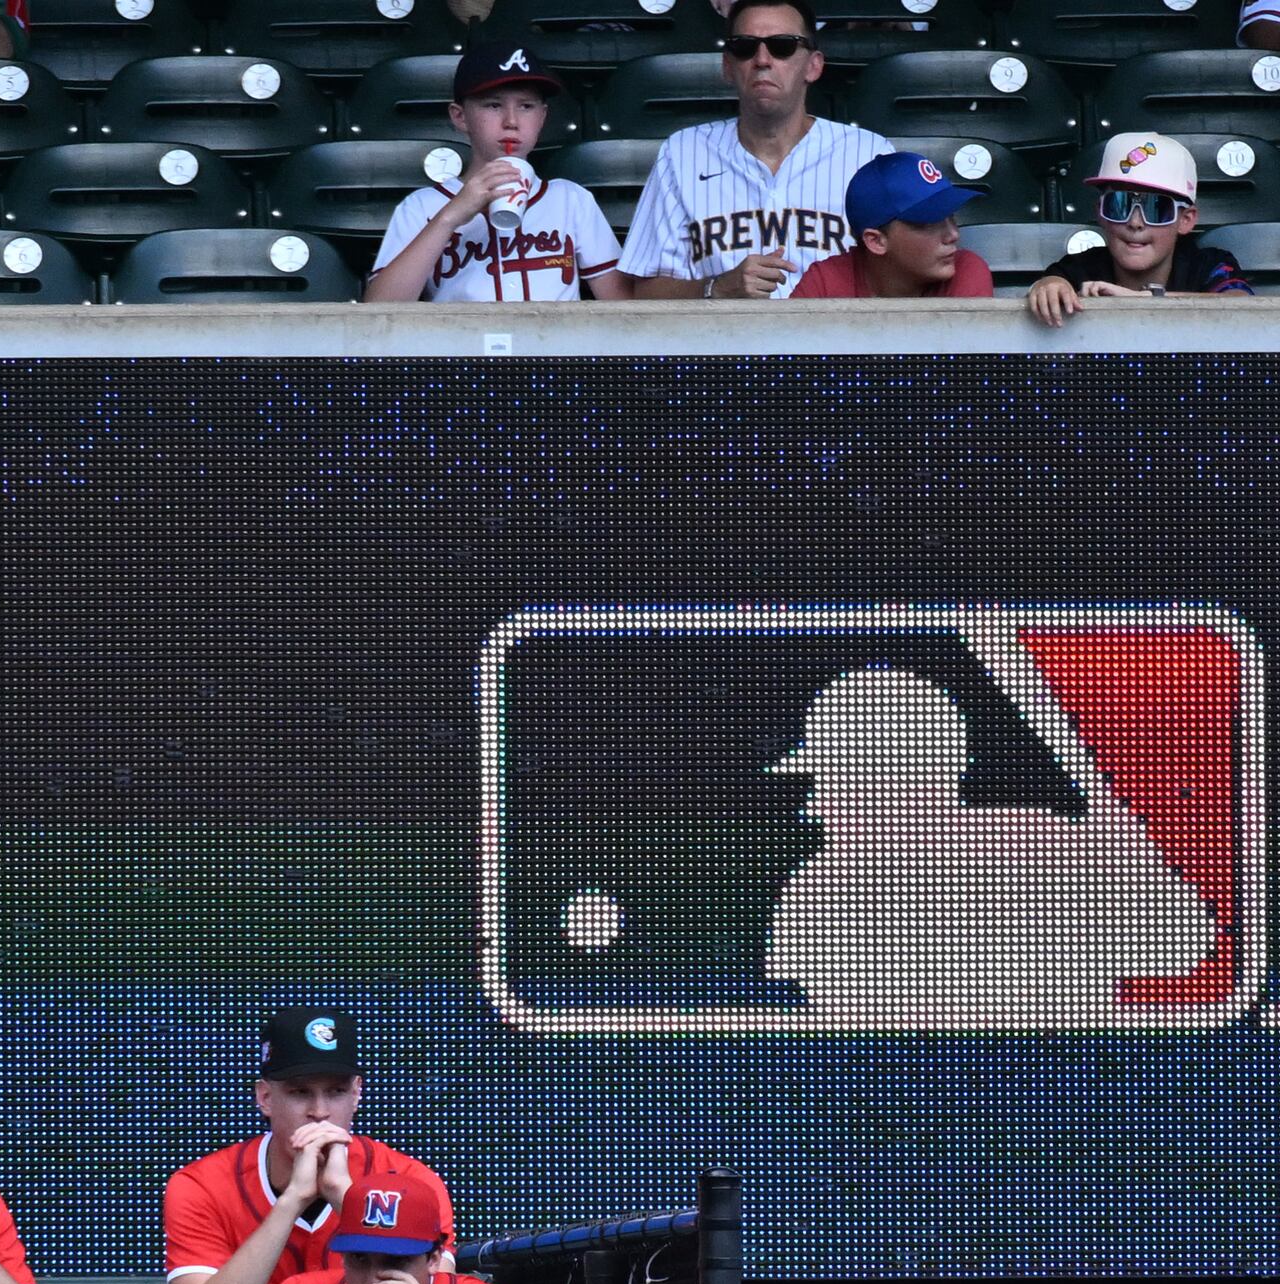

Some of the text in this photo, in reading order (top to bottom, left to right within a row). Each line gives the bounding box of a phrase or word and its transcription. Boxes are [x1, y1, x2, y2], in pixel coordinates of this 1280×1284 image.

[499, 49, 530, 72] A
[1263, 67, 1280, 81] 10
[1228, 151, 1245, 166] 10
[686, 207, 860, 264] BREWER
[362, 1190, 402, 1228] N
